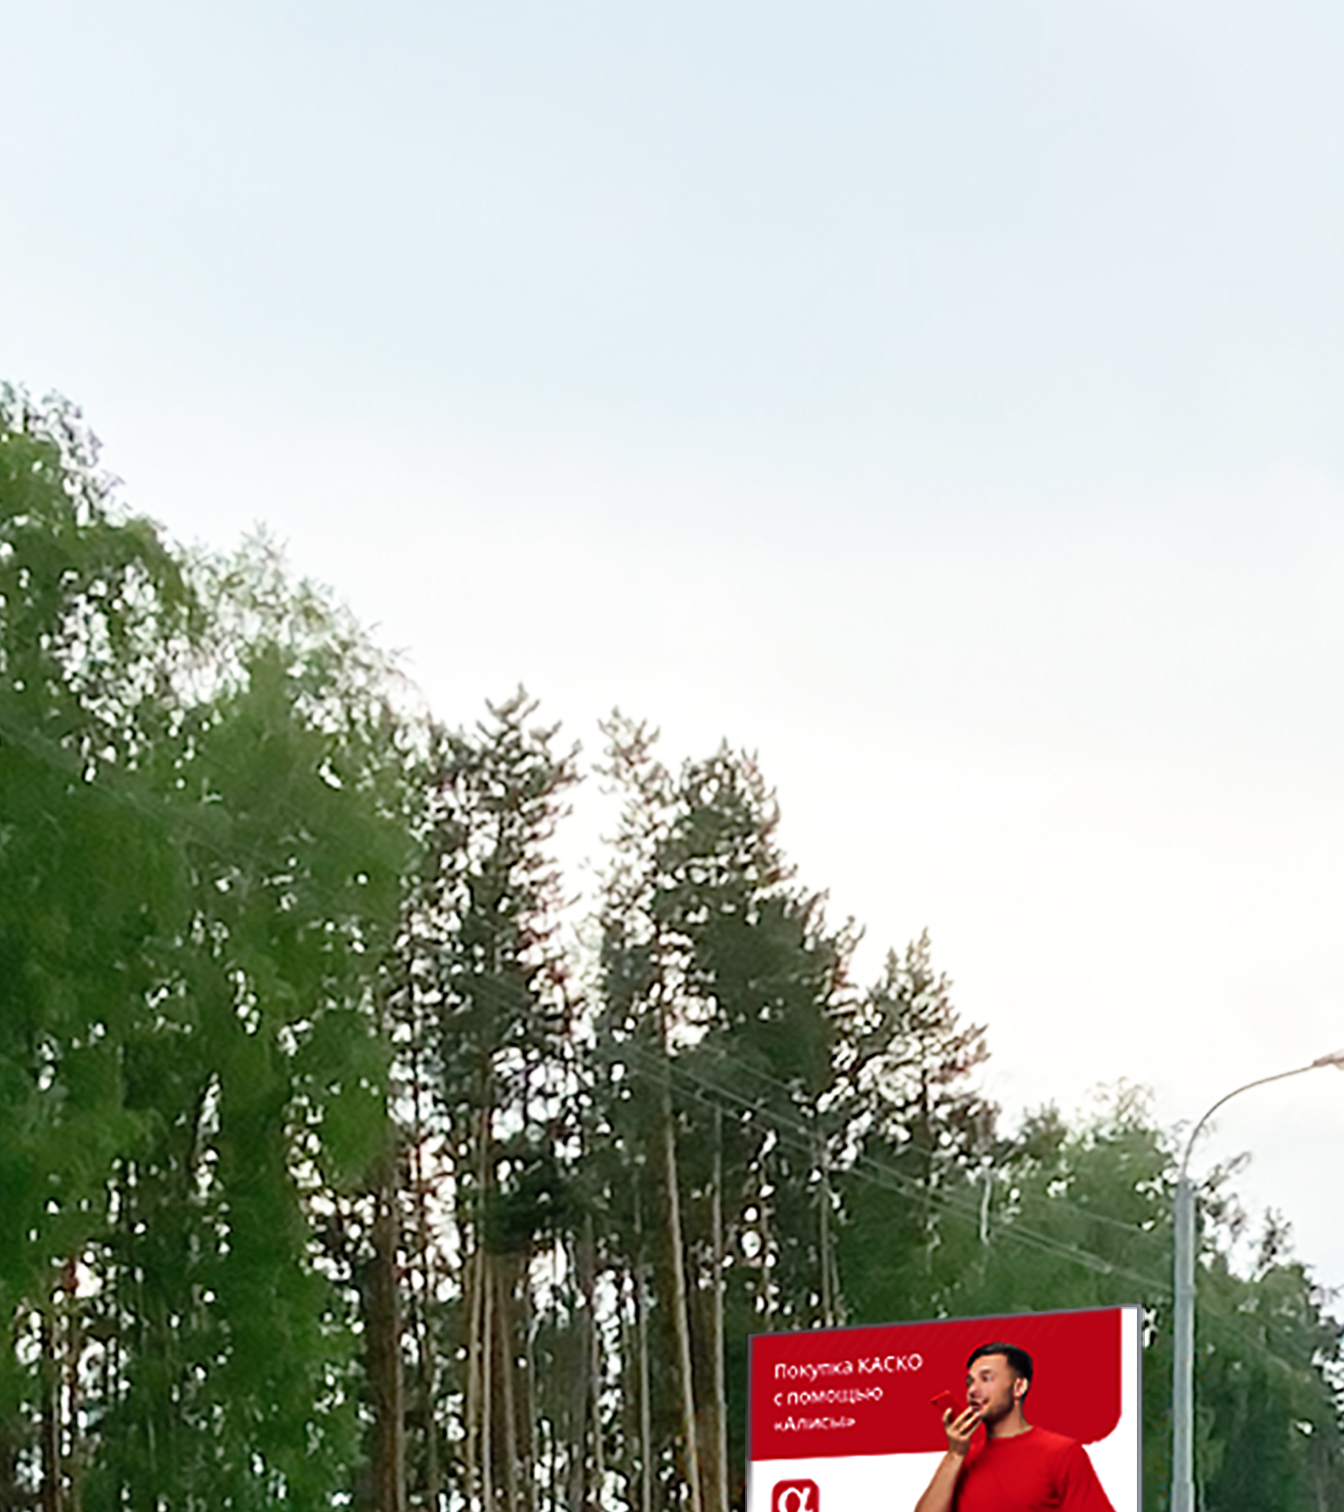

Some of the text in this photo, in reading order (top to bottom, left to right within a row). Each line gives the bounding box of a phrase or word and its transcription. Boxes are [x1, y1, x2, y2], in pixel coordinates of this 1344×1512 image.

[774, 1353, 923, 1382] Покупка КАСКО
[773, 1387, 884, 1407] с помощью
